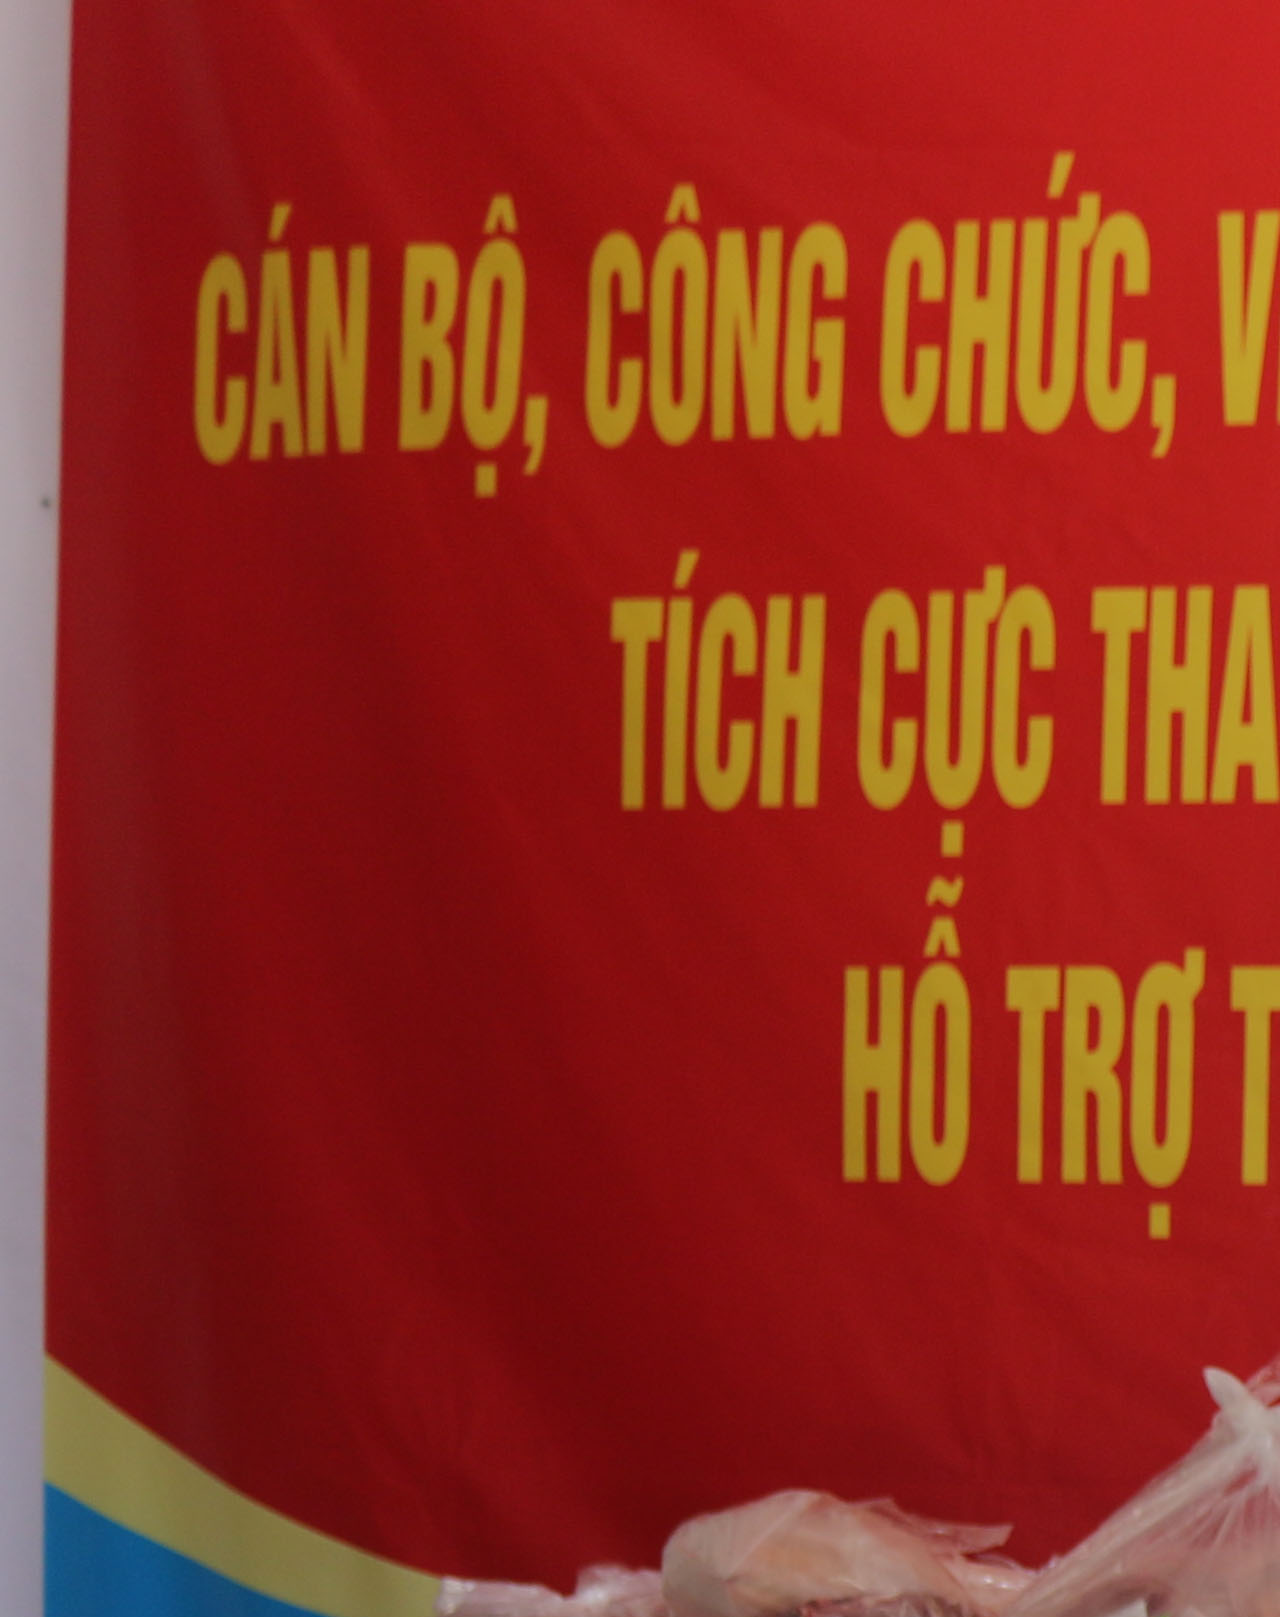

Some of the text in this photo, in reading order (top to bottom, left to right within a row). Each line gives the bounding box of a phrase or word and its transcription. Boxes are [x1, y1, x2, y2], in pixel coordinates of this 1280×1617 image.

[192, 202, 370, 464] CÁN
[398, 193, 548, 499] BỘ,
[585, 184, 849, 446] CÔNG
[880, 150, 1177, 461] CHỨC,
[611, 549, 826, 812] TÍCH
[857, 564, 1058, 858] CỰC
[842, 877, 972, 1187] HỖ
[1005, 947, 1206, 1240] TRỢ
